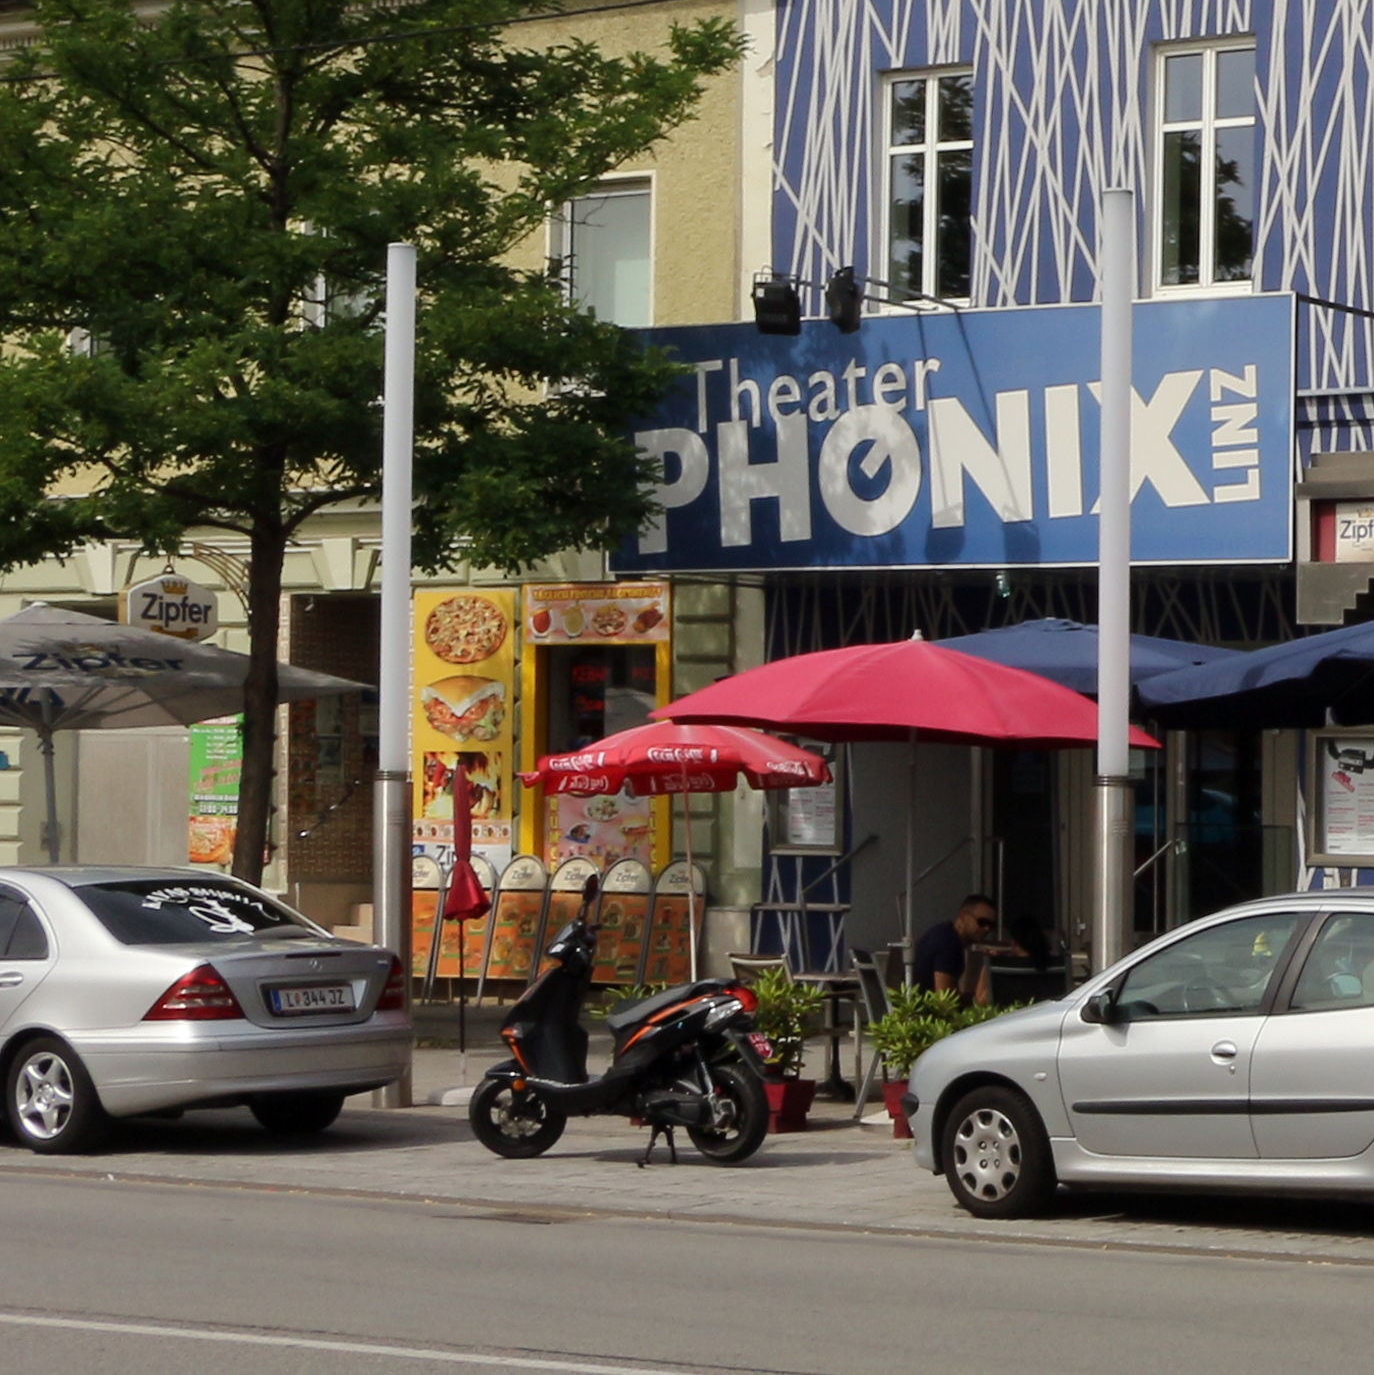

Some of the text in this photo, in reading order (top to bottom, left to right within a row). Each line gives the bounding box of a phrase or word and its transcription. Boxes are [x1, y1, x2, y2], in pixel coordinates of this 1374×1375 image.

[692, 357, 941, 434] Theater
[1210, 364, 1260, 504] LINZ
[141, 593, 212, 627] Zipfer
